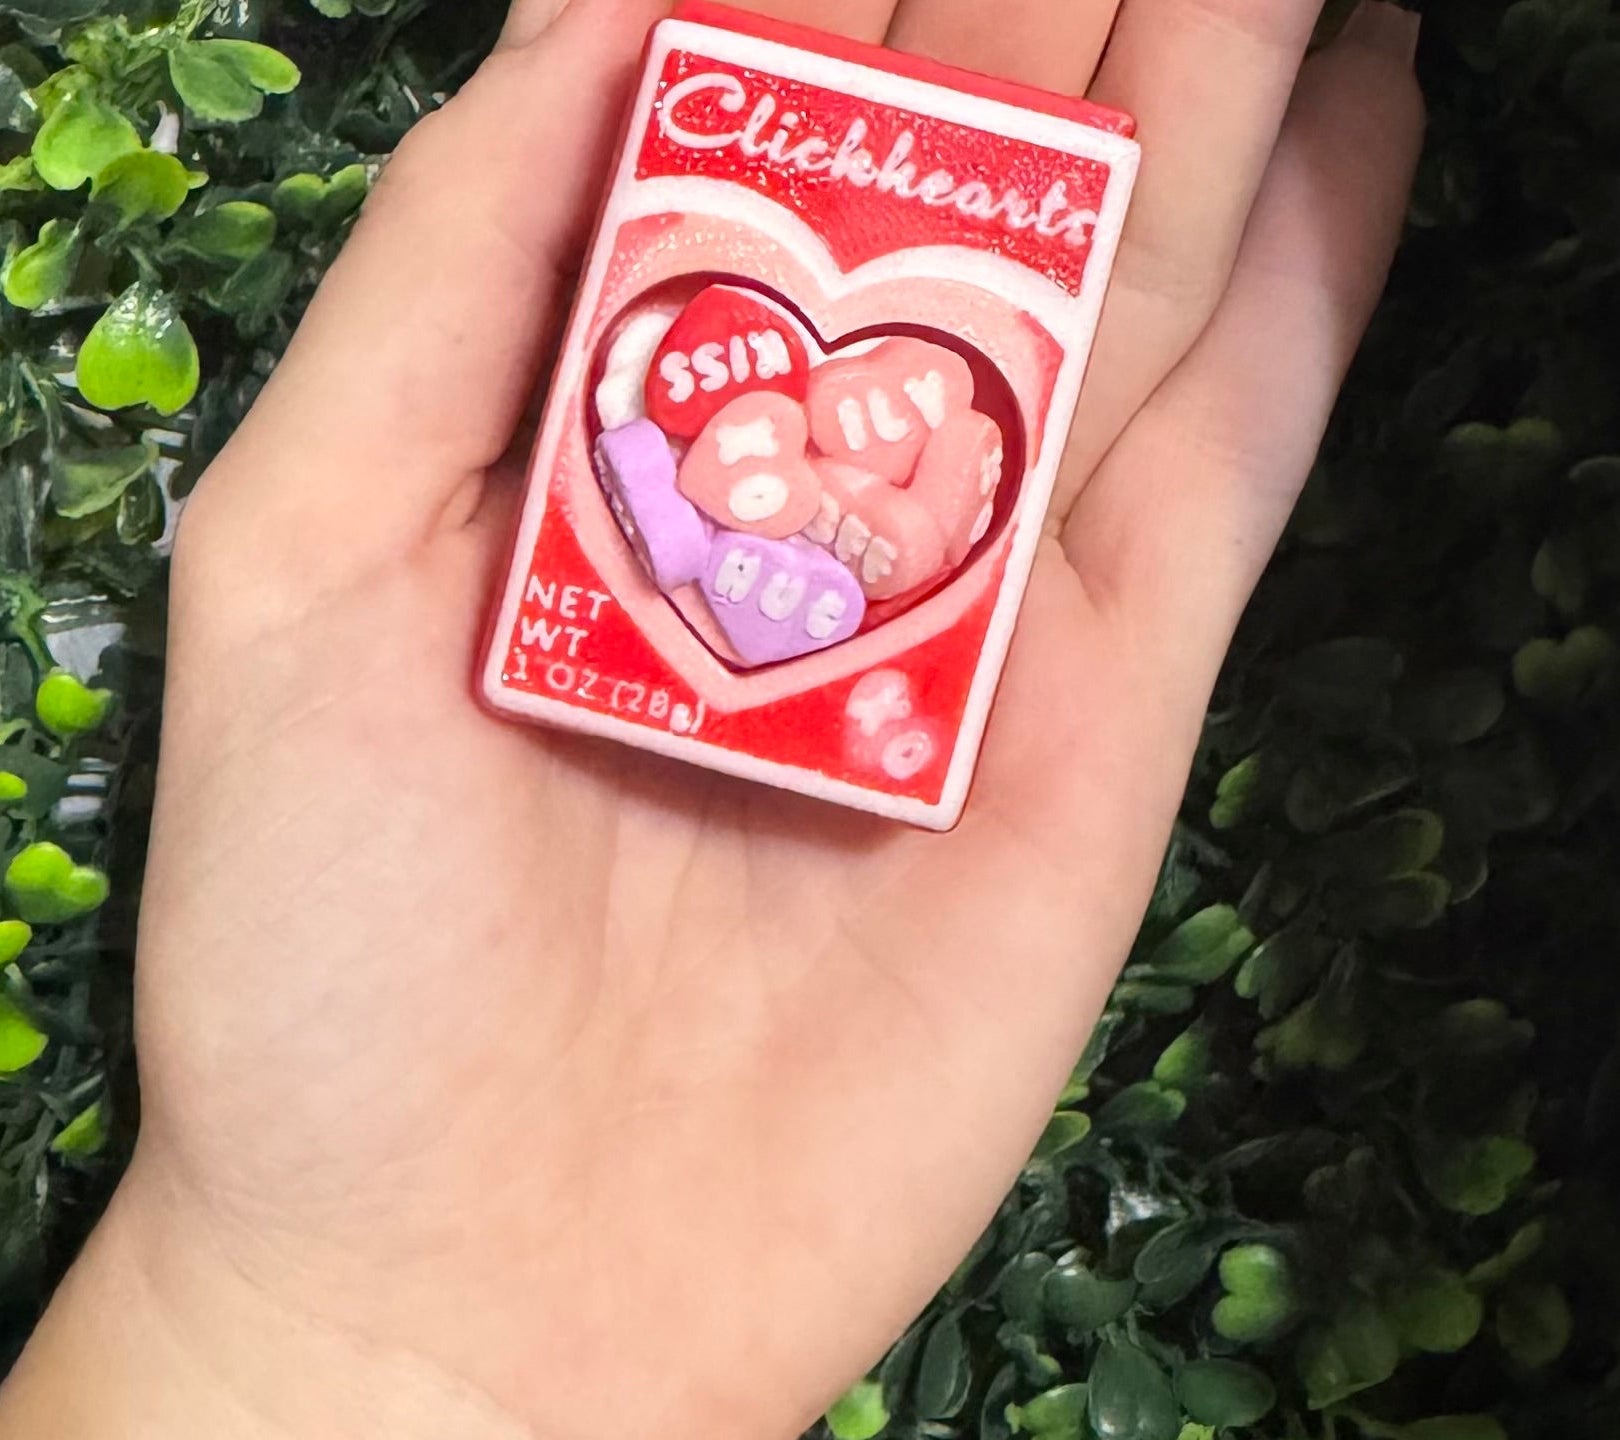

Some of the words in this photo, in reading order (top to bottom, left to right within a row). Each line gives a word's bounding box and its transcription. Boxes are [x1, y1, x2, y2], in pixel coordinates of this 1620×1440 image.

[660, 72, 1098, 245] Clickhearts
[659, 328, 792, 404] KISS
[836, 369, 947, 452] ILY
[525, 574, 612, 621] NET
[713, 547, 848, 641] HUG
[511, 646, 528, 681] 1
[545, 662, 600, 701] OZ
[520, 615, 589, 657] WT
